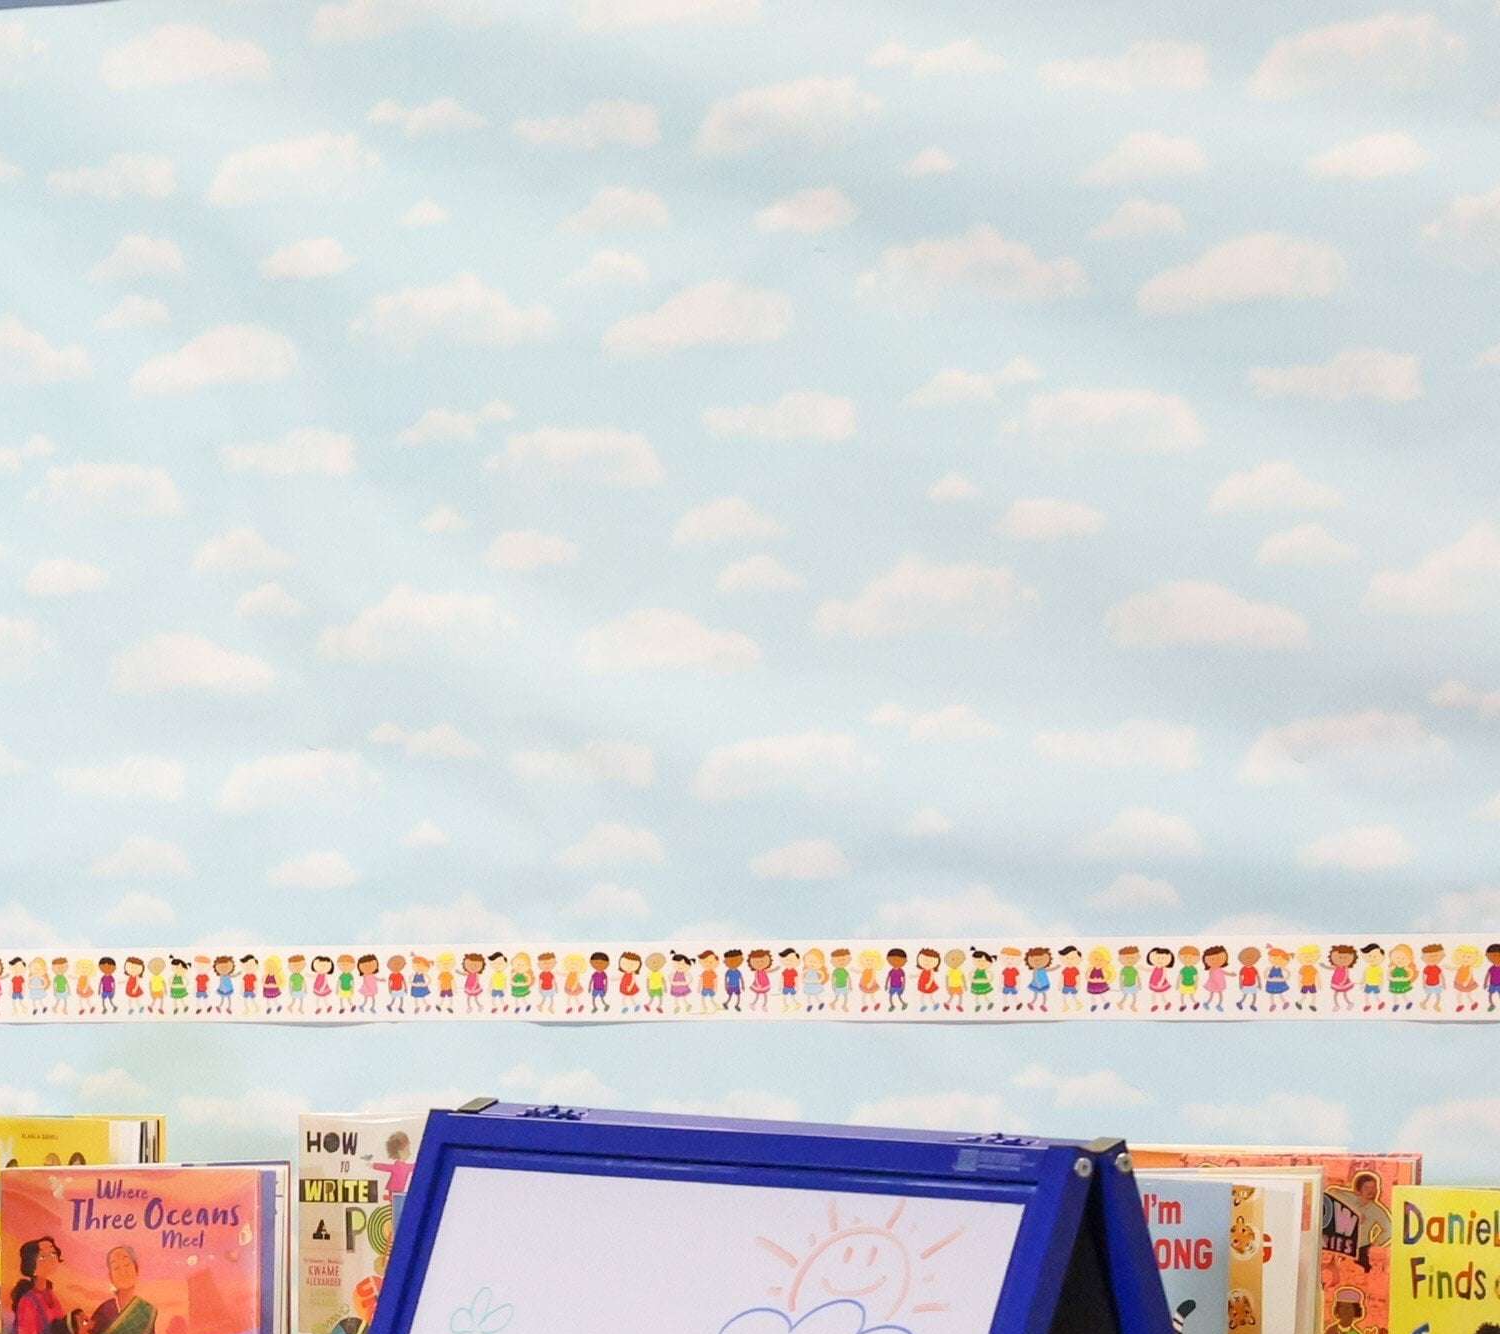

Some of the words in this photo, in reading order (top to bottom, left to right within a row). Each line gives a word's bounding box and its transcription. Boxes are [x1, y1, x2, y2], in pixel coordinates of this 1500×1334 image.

[306, 1130, 358, 1156] HOW
[340, 1160, 350, 1173] TO
[96, 1178, 149, 1200] Where
[303, 1179, 370, 1203] WRITE
[70, 1197, 138, 1231] Three
[144, 1197, 242, 1231] Oceans
[312, 1219, 331, 1240] A
[1410, 1256, 1486, 1300] Finds
